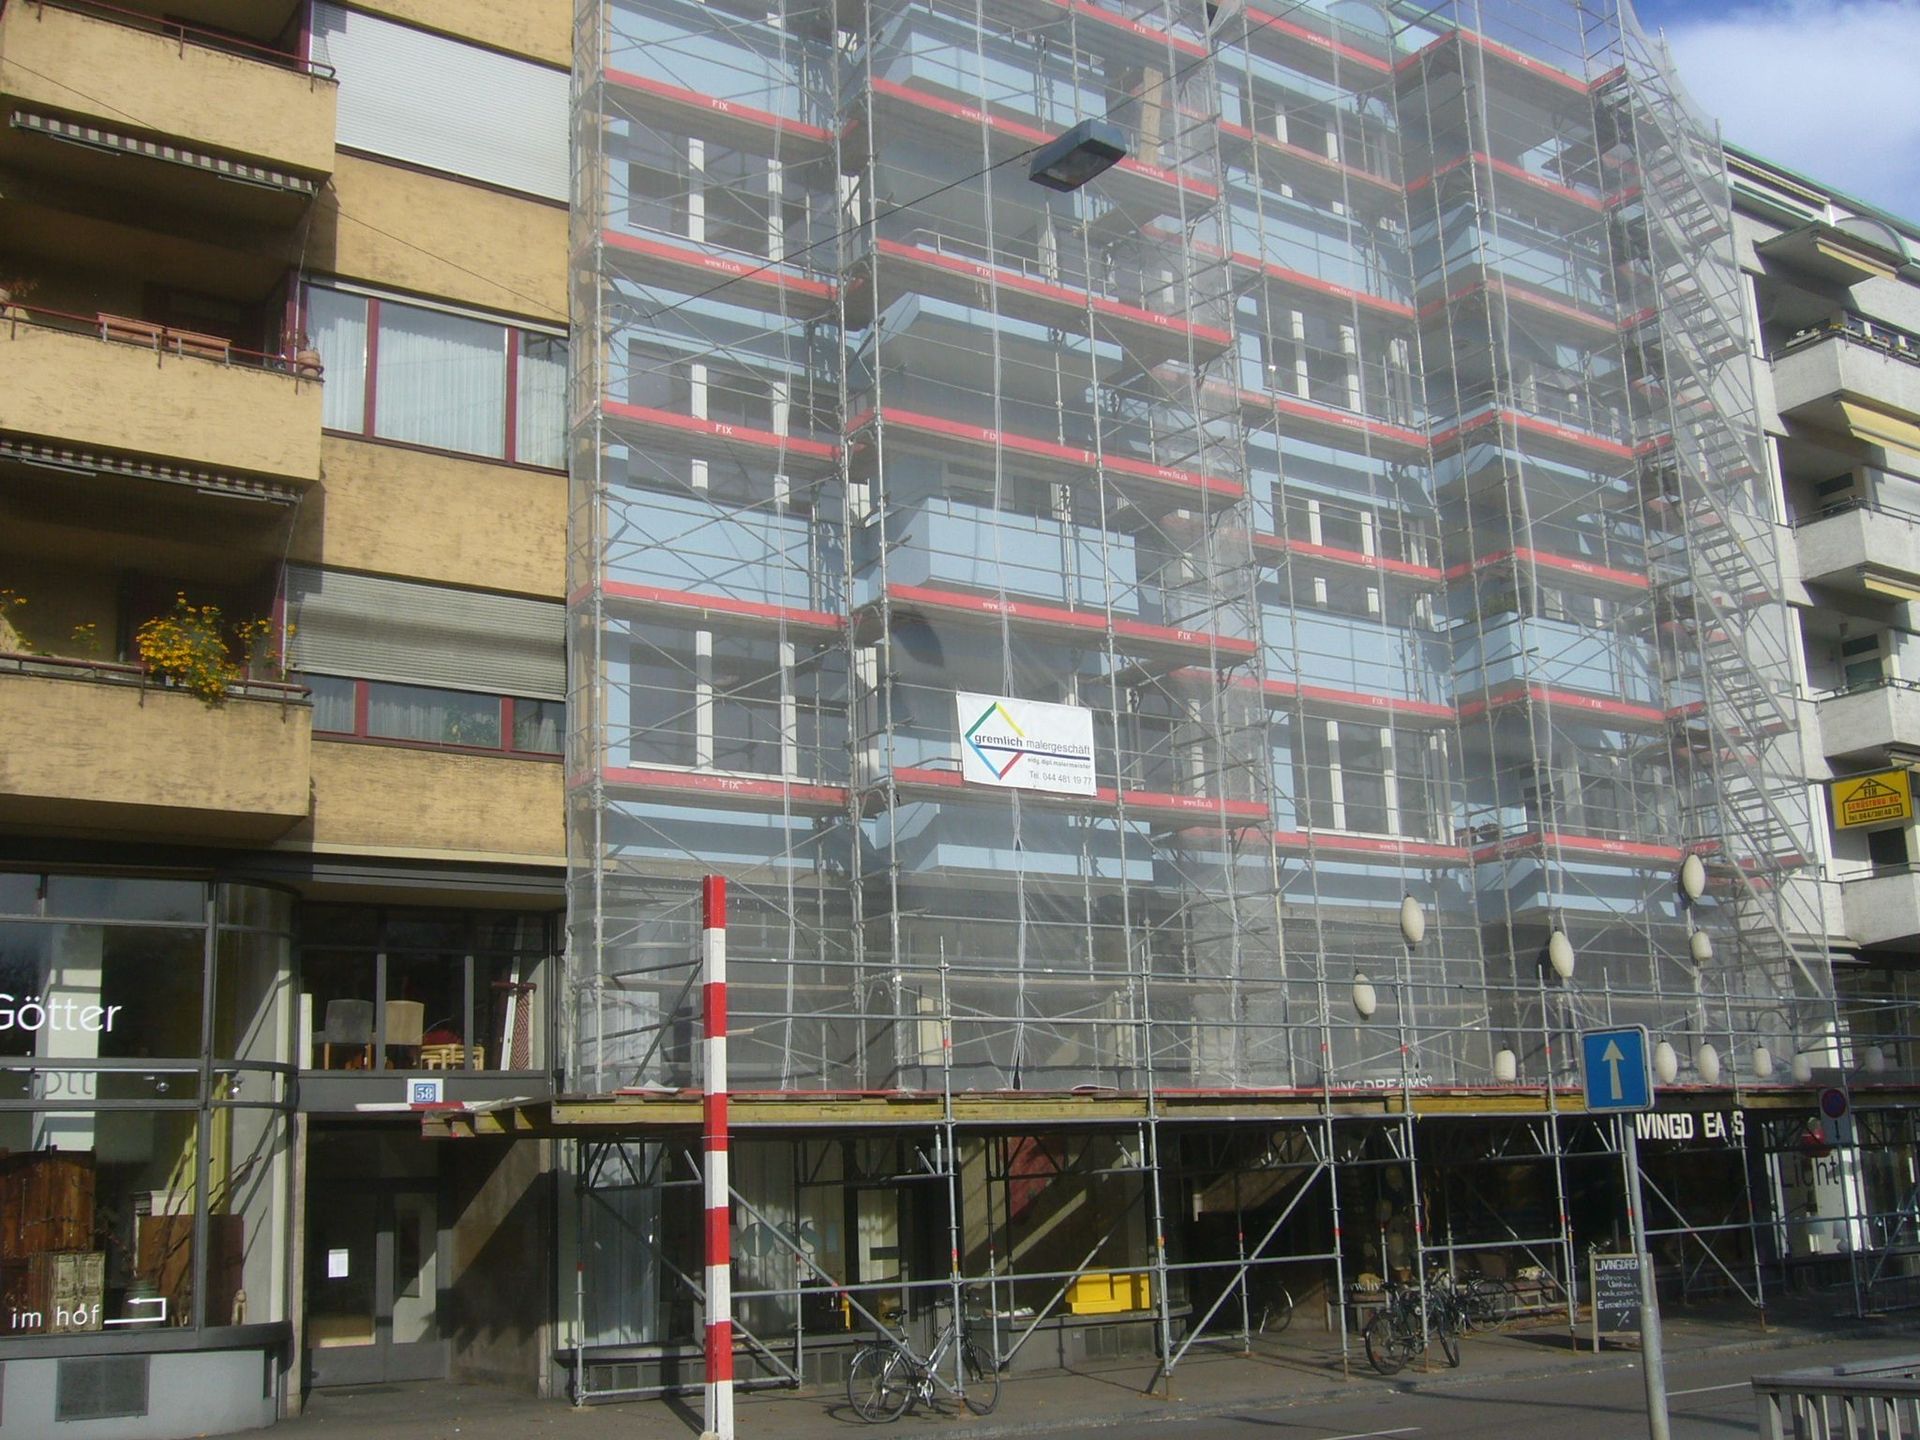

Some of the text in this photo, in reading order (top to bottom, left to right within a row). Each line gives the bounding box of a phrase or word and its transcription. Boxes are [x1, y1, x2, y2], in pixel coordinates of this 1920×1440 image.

[712, 99, 728, 111] FIX
[715, 423, 732, 434] FIX
[1177, 631, 1192, 640] FIX
[974, 734, 1090, 755] gremlich malergeschäft
[1042, 772, 1056, 782] 044
[1058, 774, 1071, 783] 481
[1084, 776, 1092, 785] 77
[416, 1087, 434, 1100] 58
[12, 1304, 101, 1329] im hof
